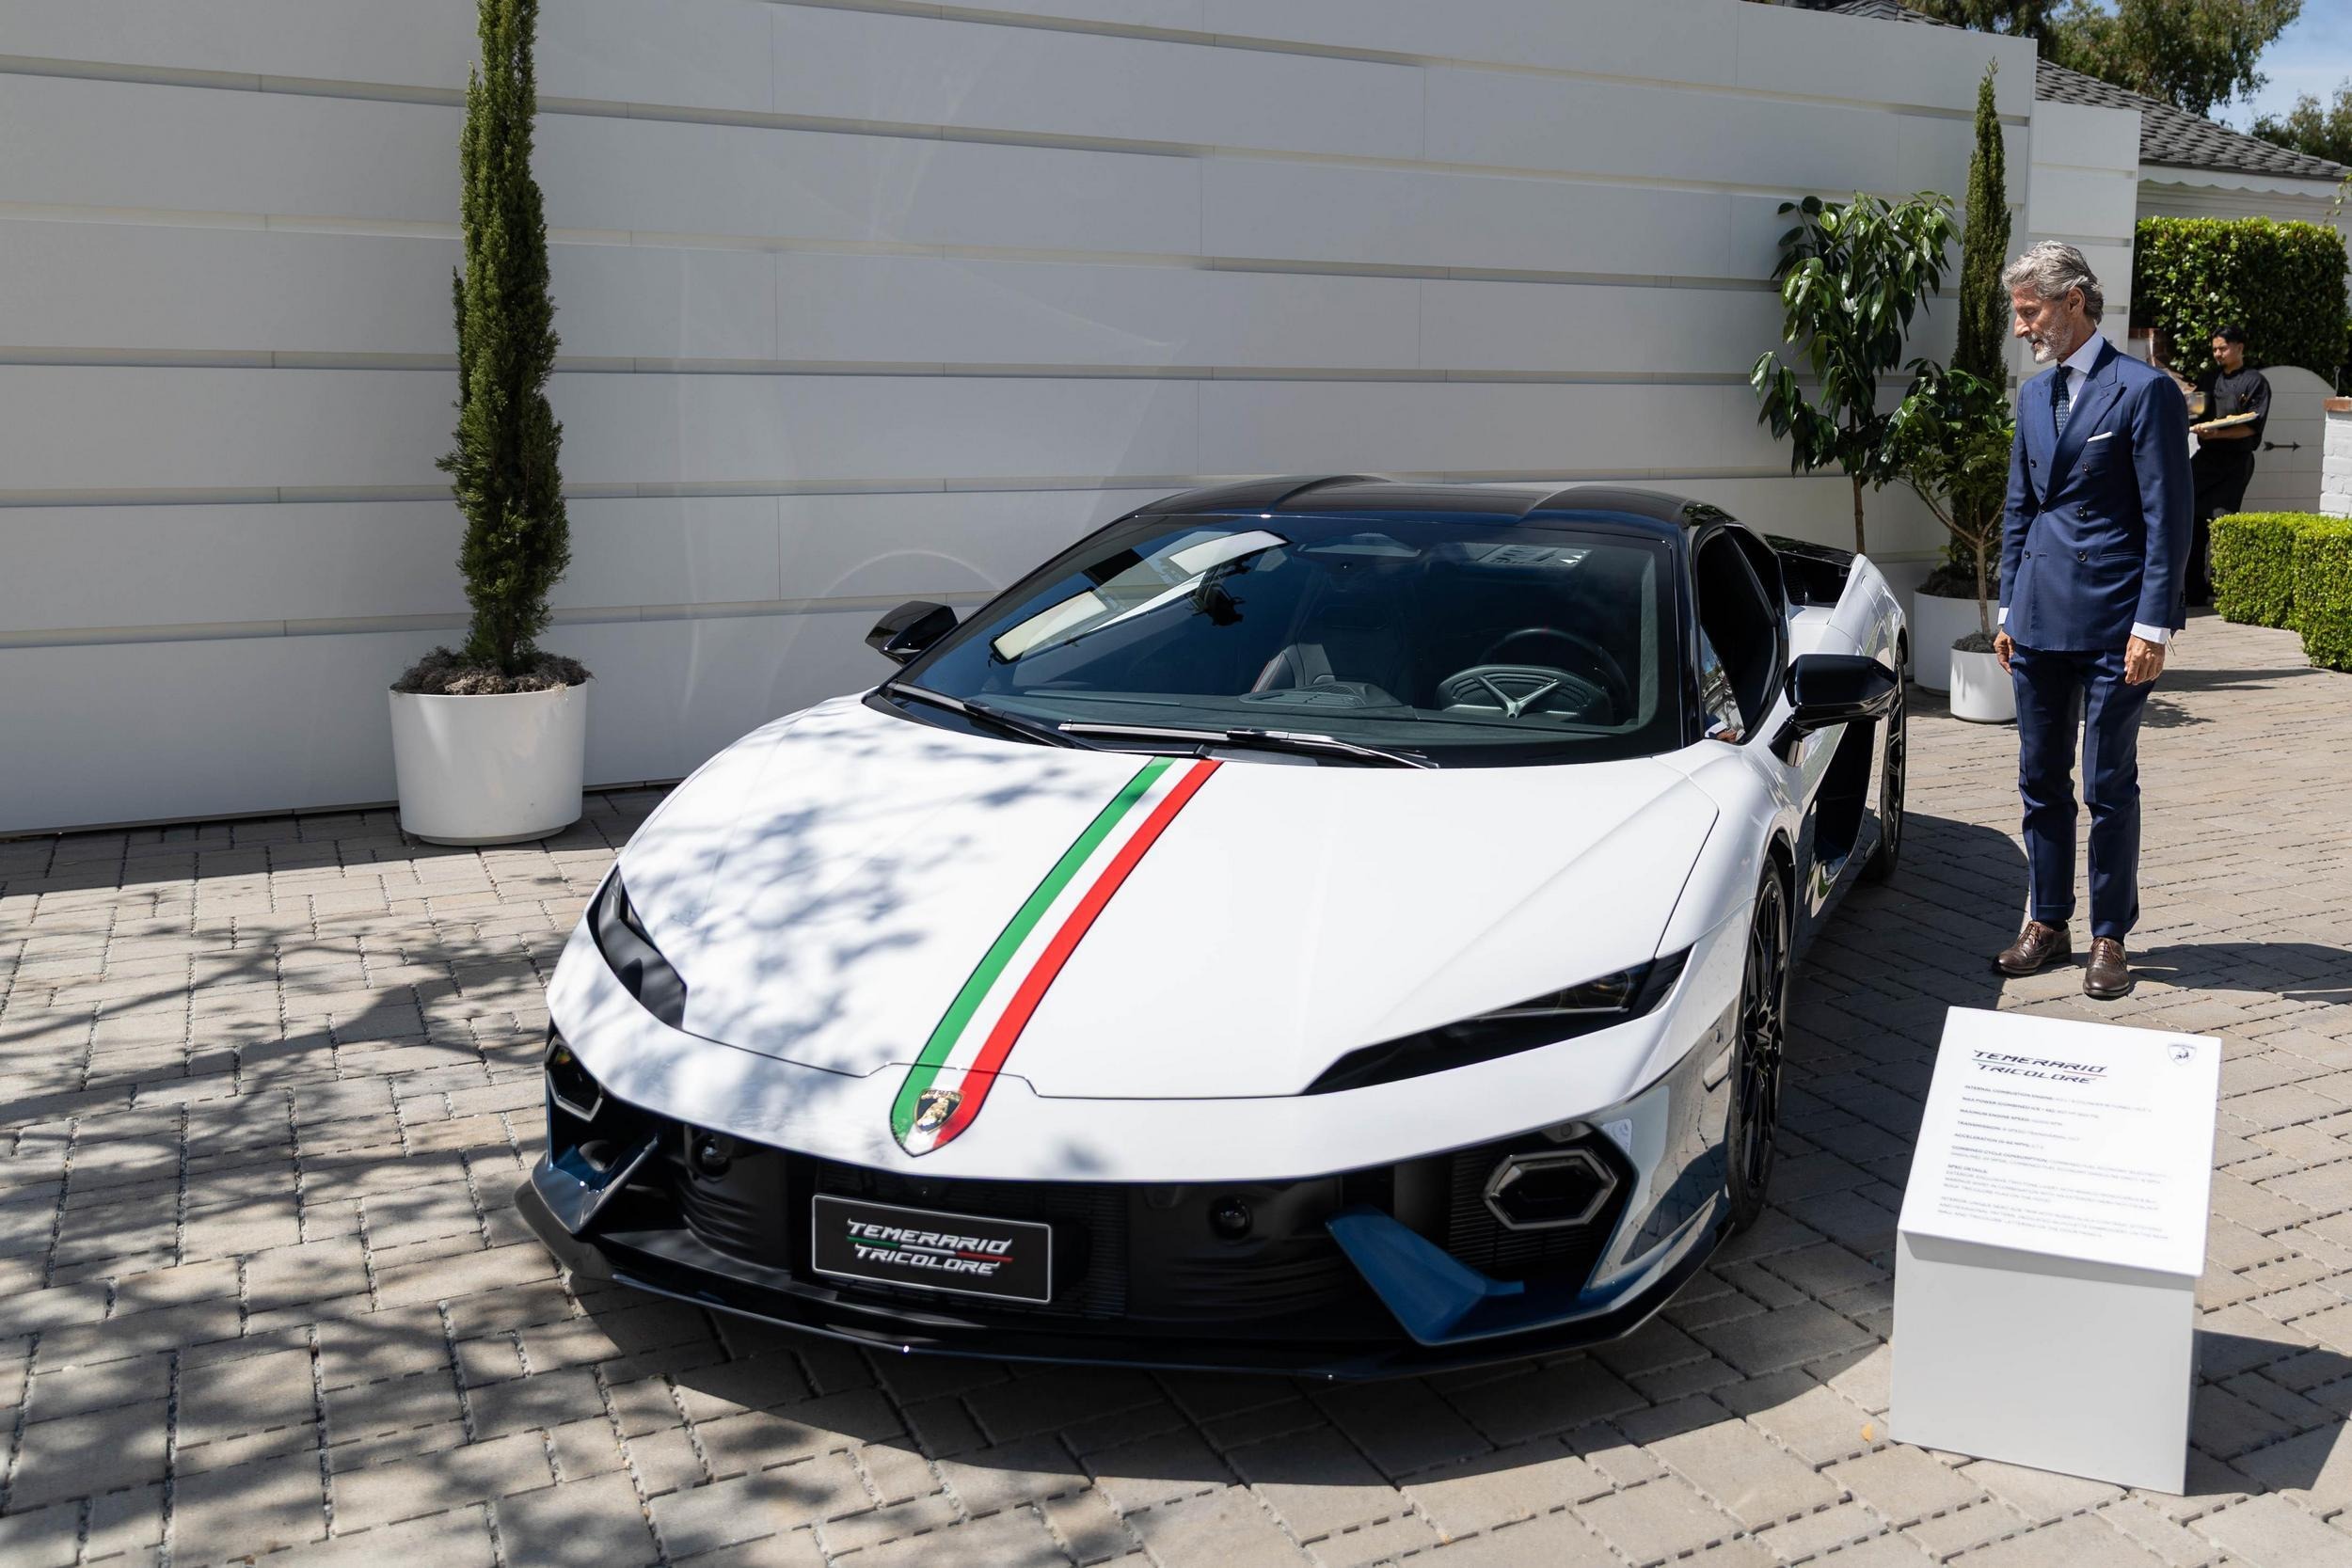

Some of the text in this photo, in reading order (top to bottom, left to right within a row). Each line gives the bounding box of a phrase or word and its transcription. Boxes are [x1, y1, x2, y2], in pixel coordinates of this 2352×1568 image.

[1974, 1050, 2107, 1074] TEMERARIO
[1978, 1063, 2097, 1085] TRICOLORE
[847, 1218, 1012, 1254] TEMERARIO
[854, 1243, 1000, 1276] TRICOLORE
